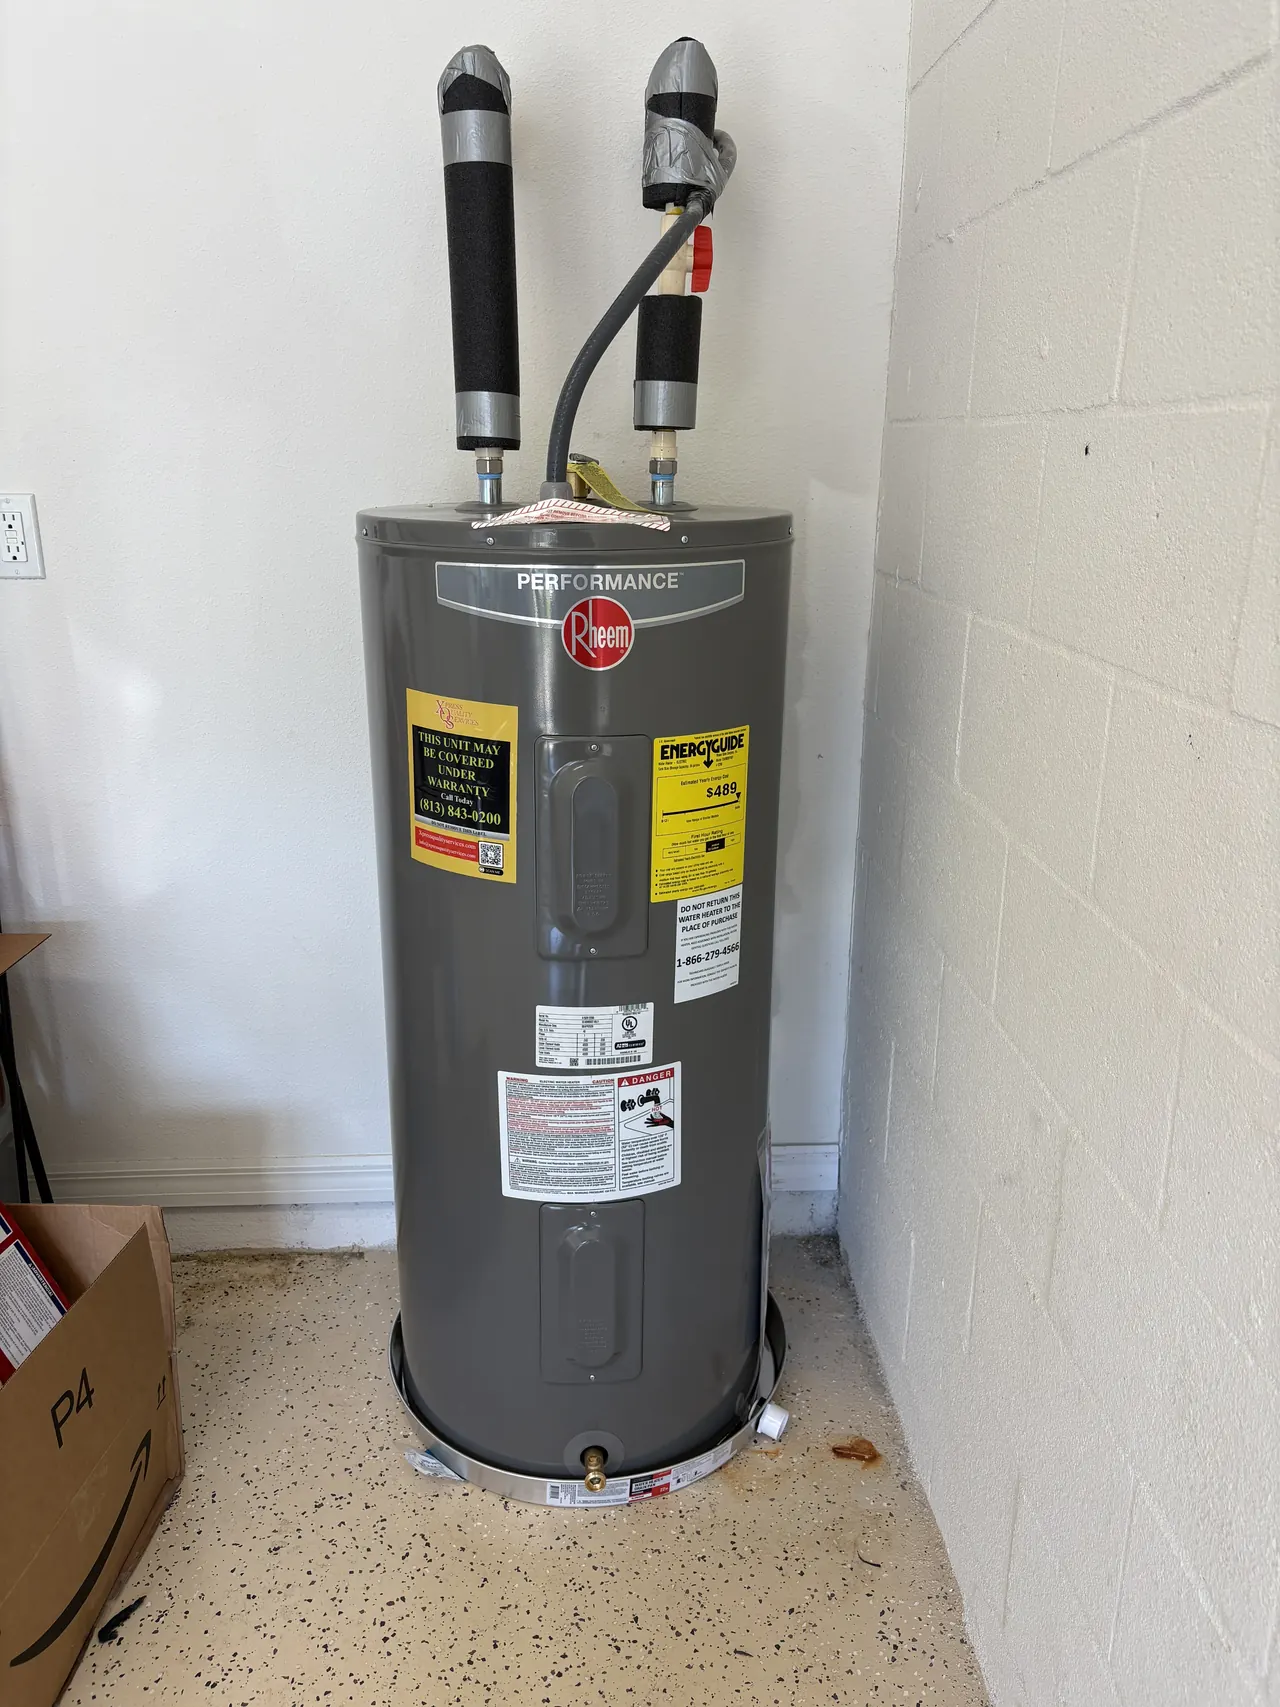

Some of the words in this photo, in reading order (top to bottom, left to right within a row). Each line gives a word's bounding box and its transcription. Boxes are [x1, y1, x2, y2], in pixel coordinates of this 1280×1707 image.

[517, 573, 679, 591] PERFORMANCE
[571, 600, 629, 658] Rheem
[418, 731, 441, 746] THIS
[444, 737, 470, 751] UNIT
[473, 742, 501, 756] MAY
[660, 733, 744, 761] ENERGYGUIDE
[424, 746, 436, 758] BE
[438, 750, 494, 769] COVERED
[438, 764, 476, 781] UNDER
[428, 776, 490, 797] WARRANTY
[706, 781, 737, 798] $489
[441, 793, 453, 801] Call
[454, 795, 473, 806] Today
[420, 798, 445, 817] (813)
[447, 804, 501, 825] 843-0200
[681, 905, 691, 913] DO
[692, 902, 705, 912] NOT
[708, 896, 728, 907] RETURN
[679, 913, 700, 923] WATER
[702, 908, 722, 918] HEATER
[682, 924, 700, 932] PLACE
[702, 920, 710, 928] OF
[711, 912, 738, 926] PURCHASE
[676, 942, 739, 967] 1-866-279-4566
[626, 1019, 633, 1028] UL
[632, 1071, 671, 1084] DANGER
[51, 1367, 94, 1449] P4
